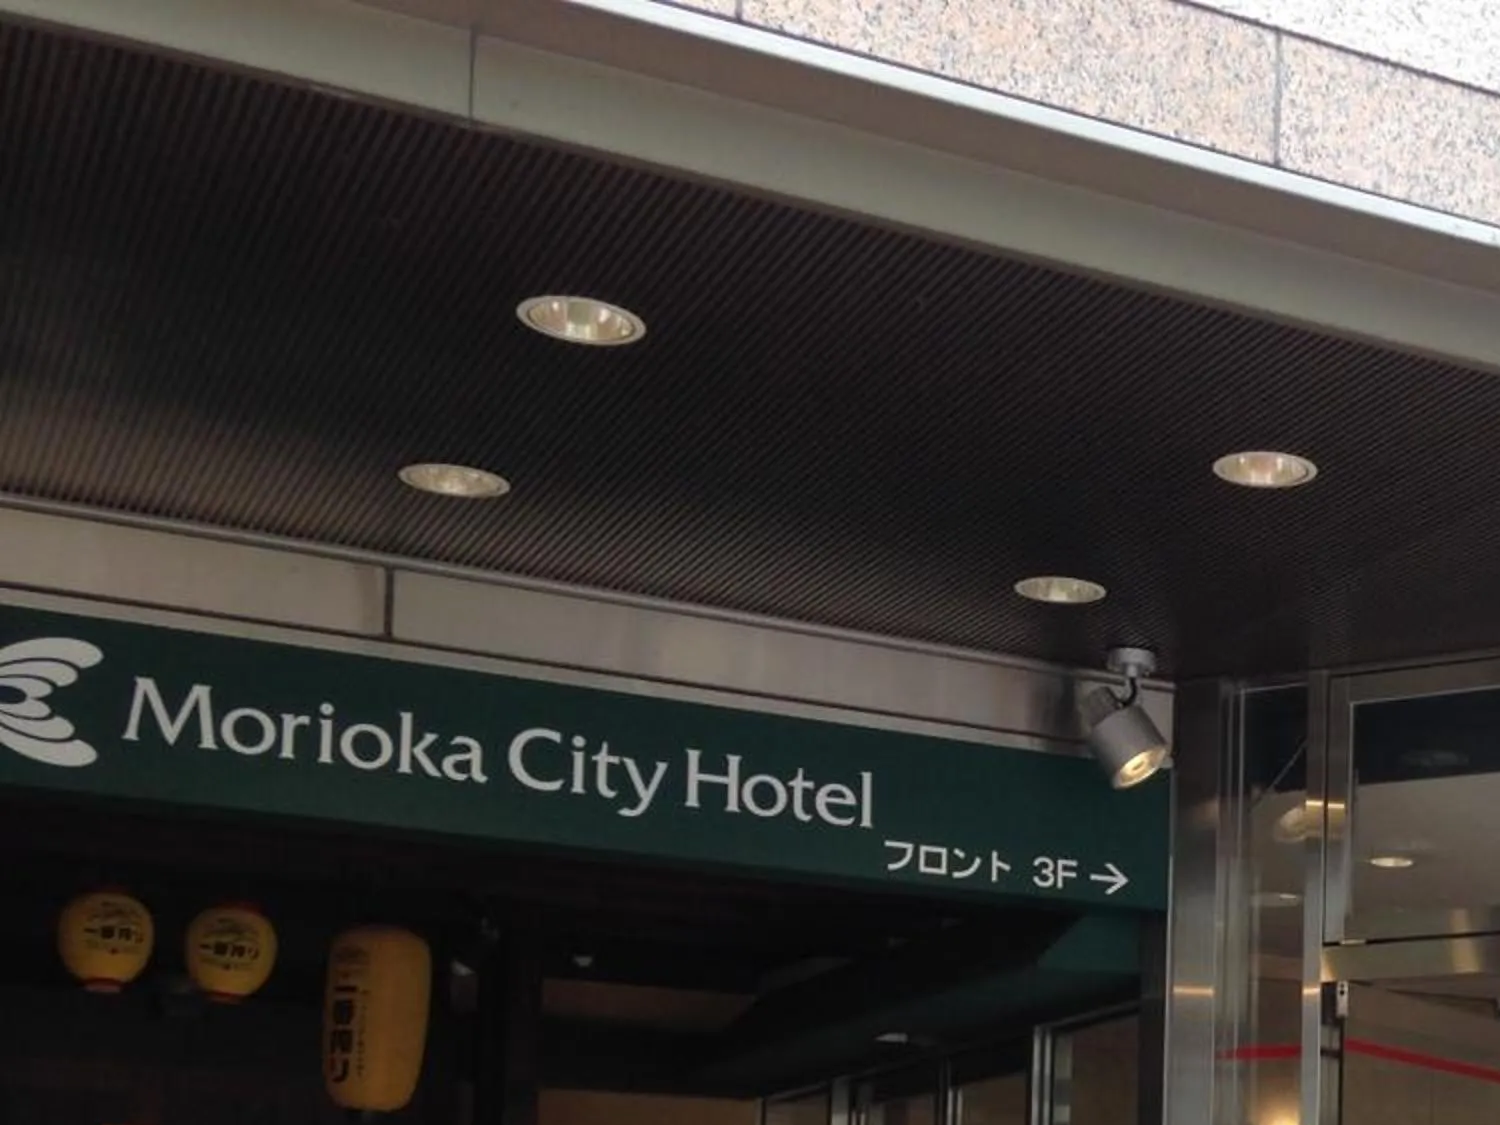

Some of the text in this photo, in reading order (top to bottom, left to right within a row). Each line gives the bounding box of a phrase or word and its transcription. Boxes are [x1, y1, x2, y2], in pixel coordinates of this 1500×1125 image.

[122, 676, 874, 829] Morioka City Hotel
[884, 840, 1078, 889] フロント 3F
